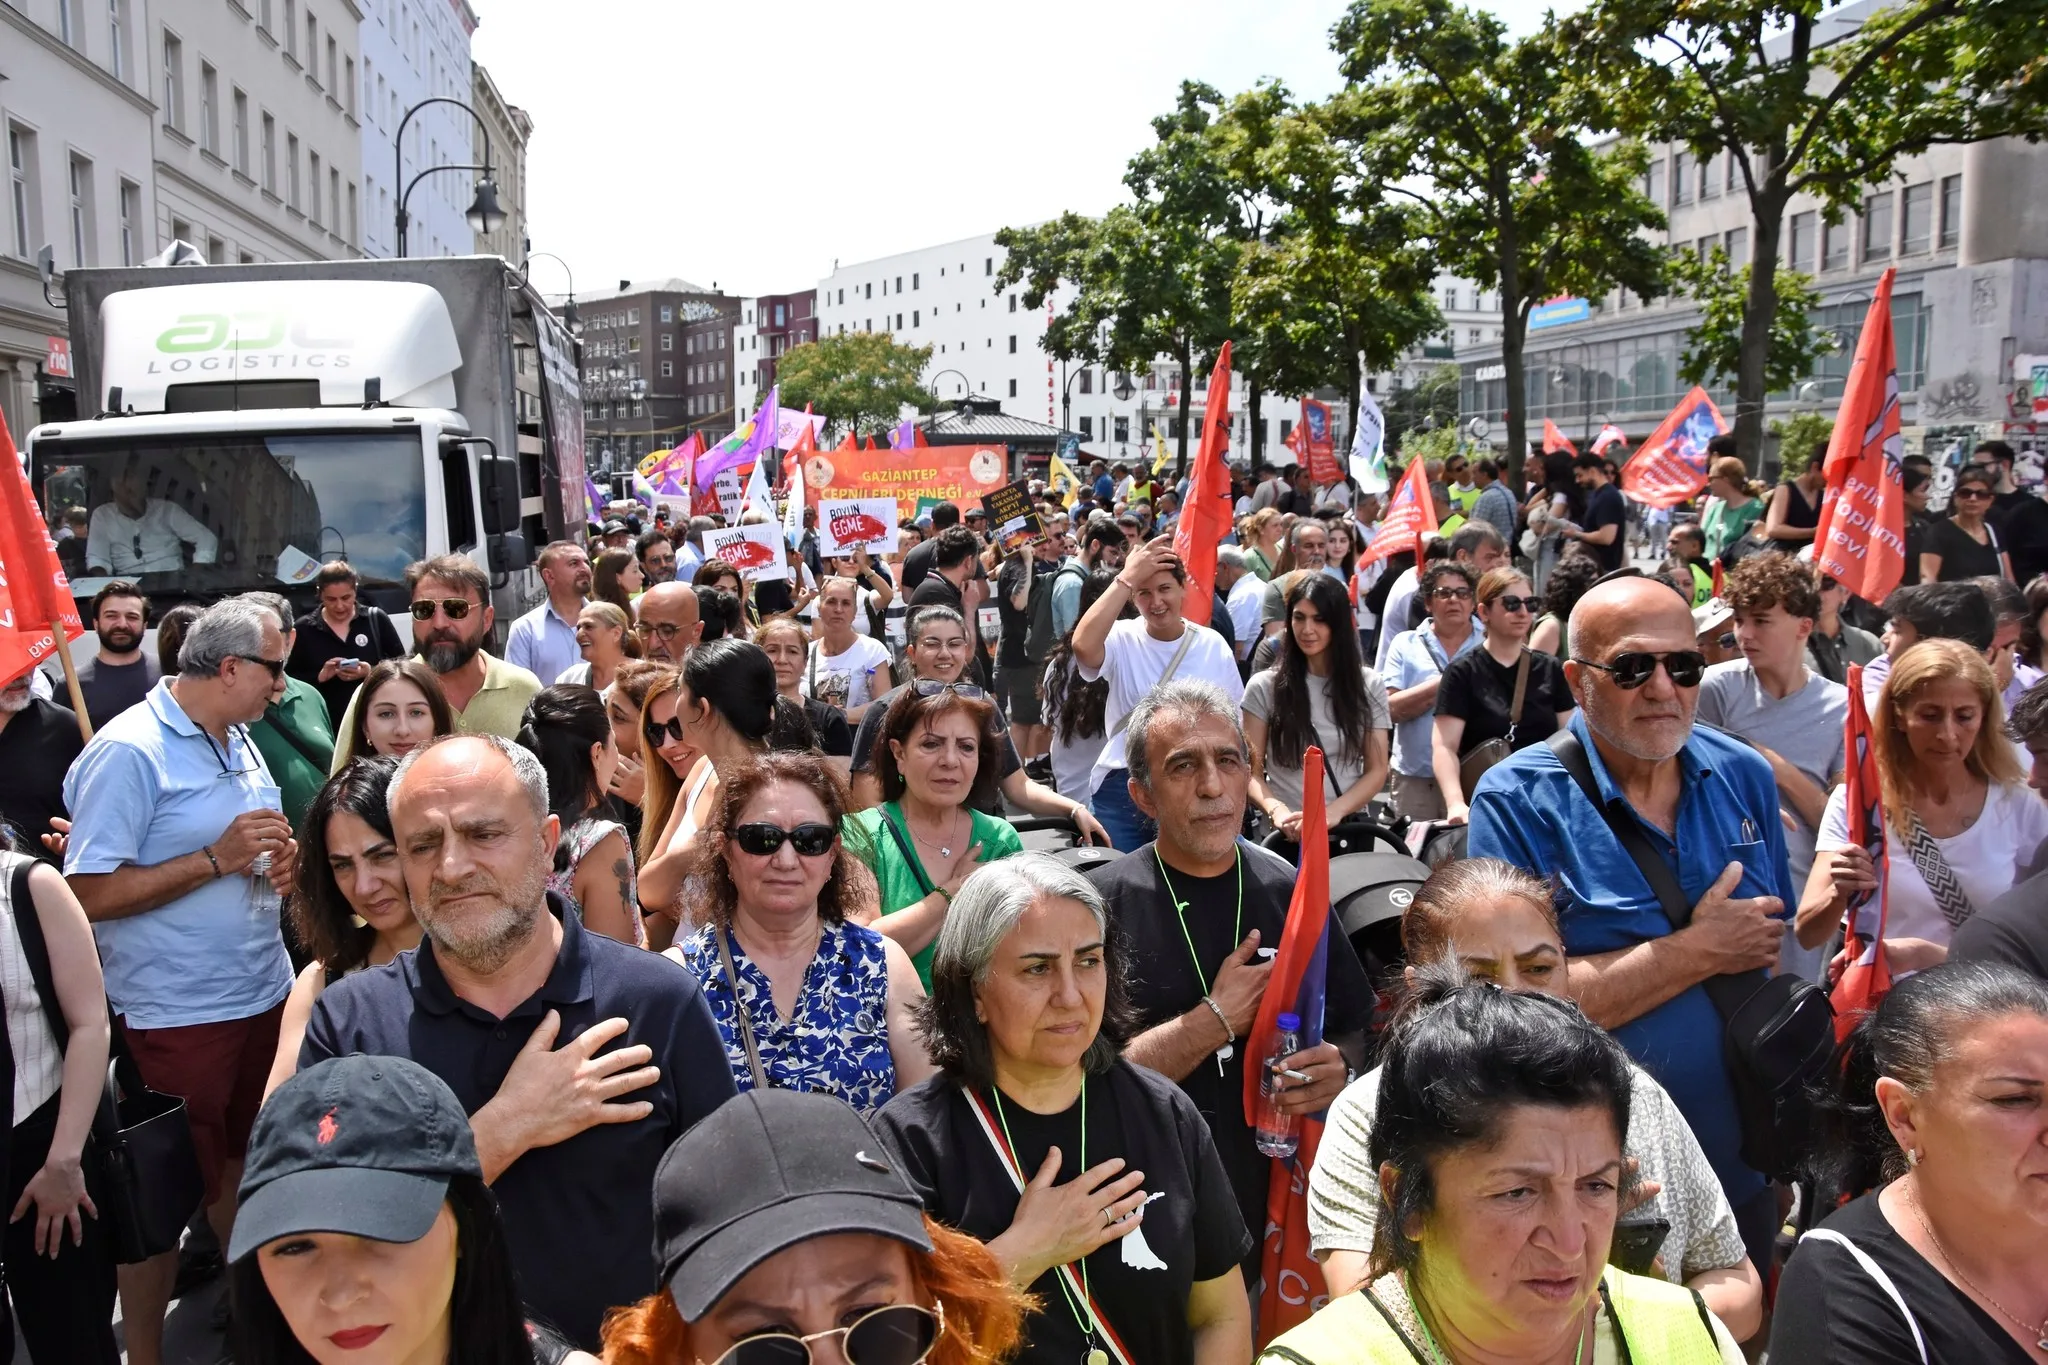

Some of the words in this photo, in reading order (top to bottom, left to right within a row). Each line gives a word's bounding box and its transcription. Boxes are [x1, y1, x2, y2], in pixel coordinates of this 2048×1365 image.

[147, 354, 351, 374] LOGISTICS
[1475, 364, 1506, 382] KARST
[862, 468, 938, 482] GAZİANTEP
[897, 484, 962, 501] DERNEĞİ
[1844, 477, 1884, 509] erlin
[829, 503, 860, 521] BOYUN
[714, 530, 746, 550] BOYUN
[870, 536, 889, 545] NICHT
[759, 561, 777, 570] NICHT
